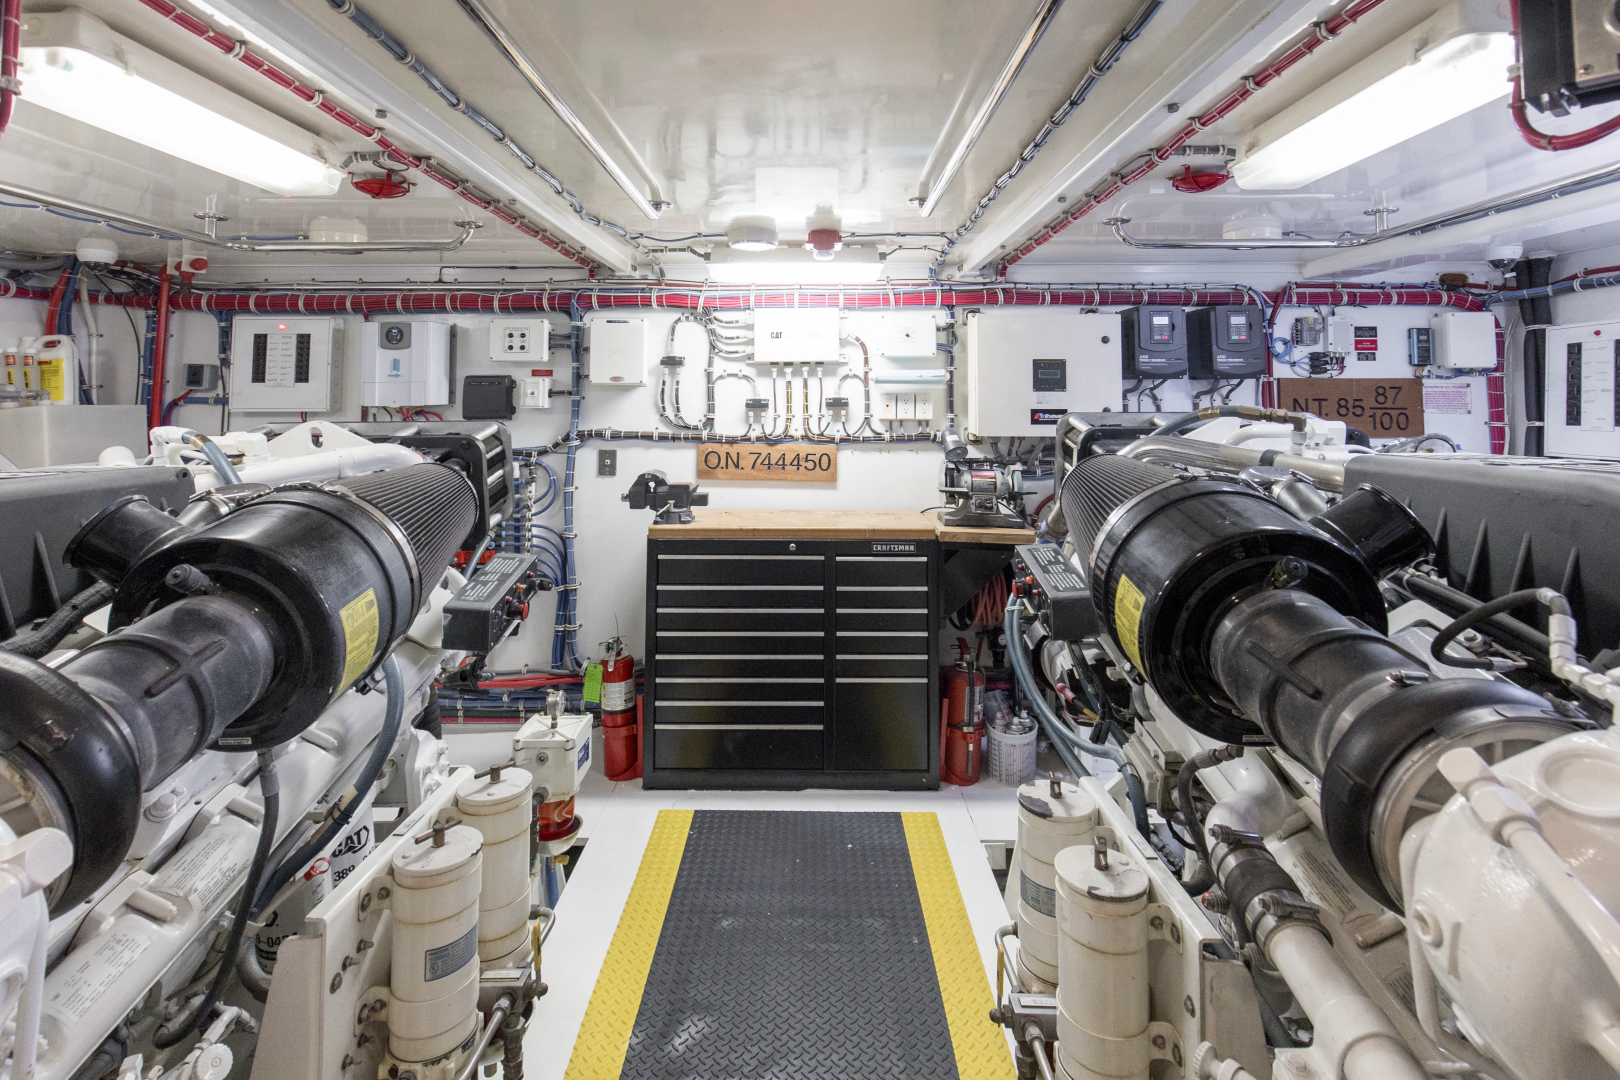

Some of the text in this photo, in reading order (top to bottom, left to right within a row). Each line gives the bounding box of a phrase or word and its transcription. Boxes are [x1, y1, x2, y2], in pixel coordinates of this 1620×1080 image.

[770, 331, 783, 339] CAT
[1374, 385, 1403, 406] 87
[1336, 397, 1366, 418] 85
[1368, 411, 1410, 431] 100
[704, 450, 832, 473] O.N. 744450
[872, 544, 915, 552] CRAFTSMAN
[331, 827, 363, 858] CAT
